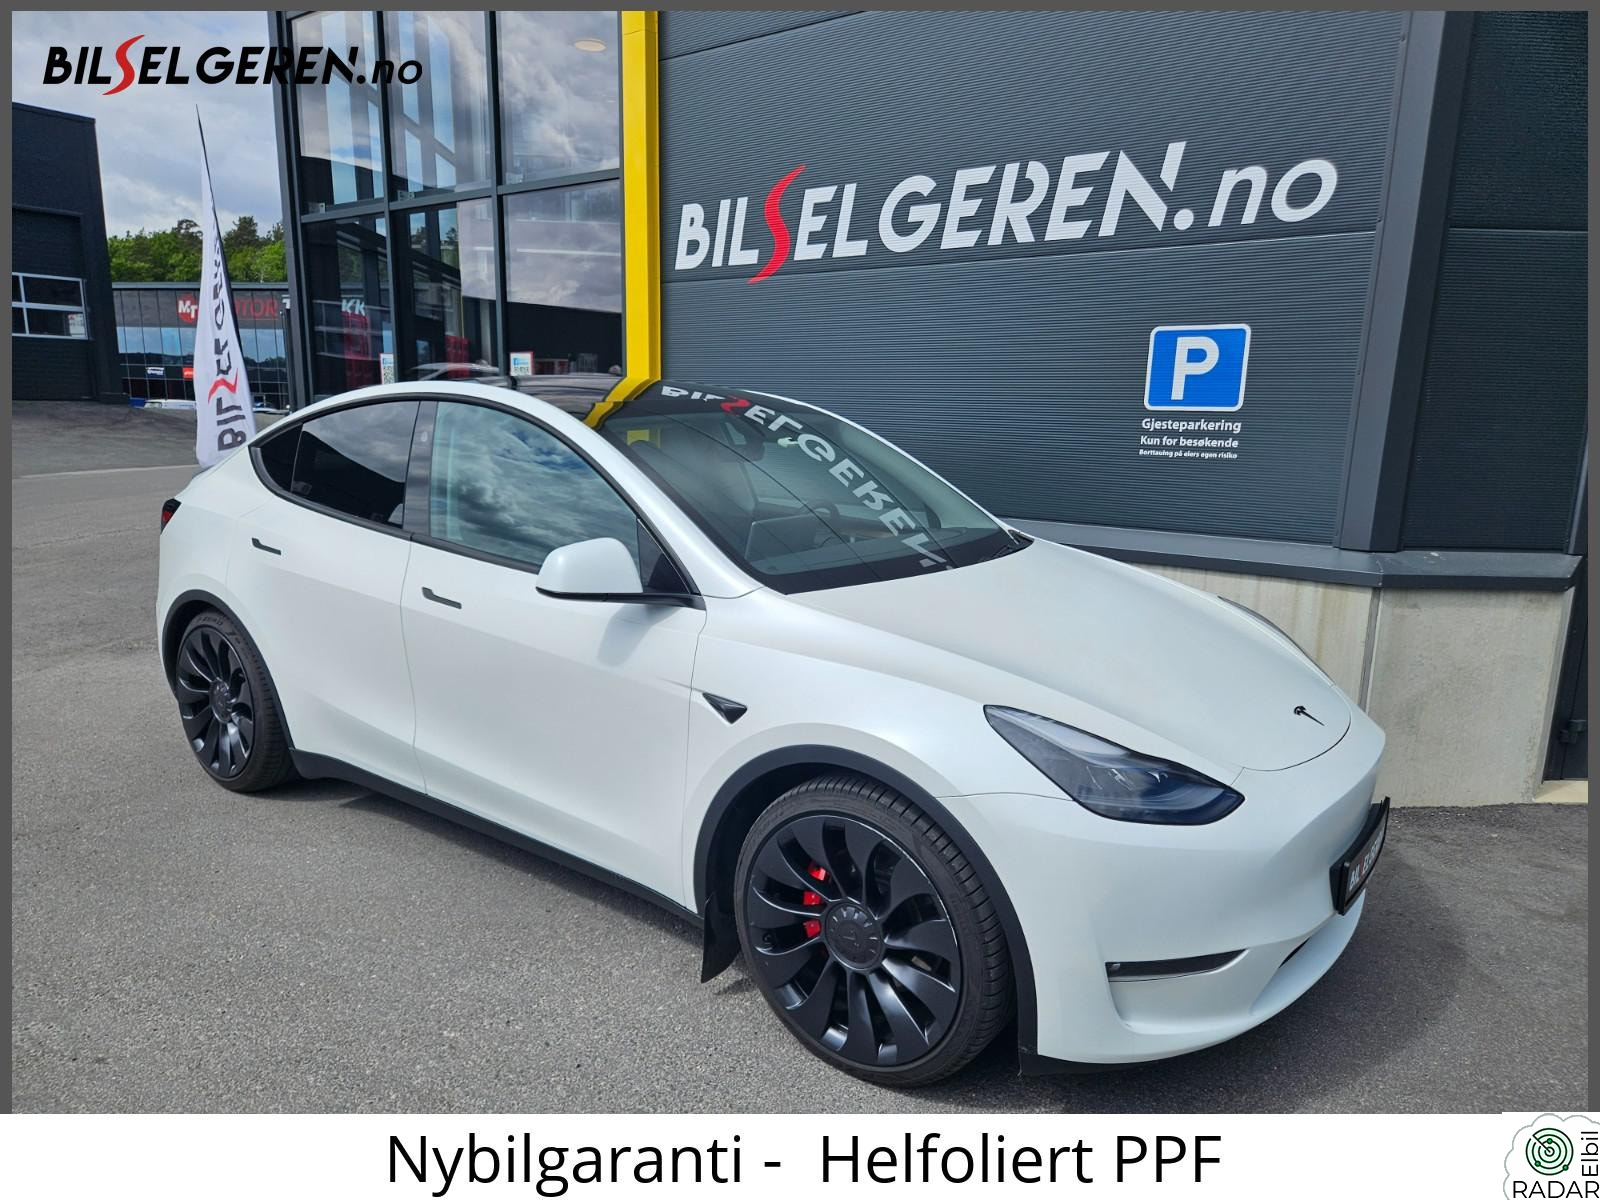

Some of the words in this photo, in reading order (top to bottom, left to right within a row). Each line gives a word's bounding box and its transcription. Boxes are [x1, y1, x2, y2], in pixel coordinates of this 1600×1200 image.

[674, 140, 1339, 285] BILSELGEREN.no
[1171, 336, 1219, 400] P
[1140, 435, 1160, 446] Kun
[1162, 435, 1178, 446] for
[1179, 436, 1239, 448] besøkende
[1141, 418, 1242, 433] Gjesteparkering
